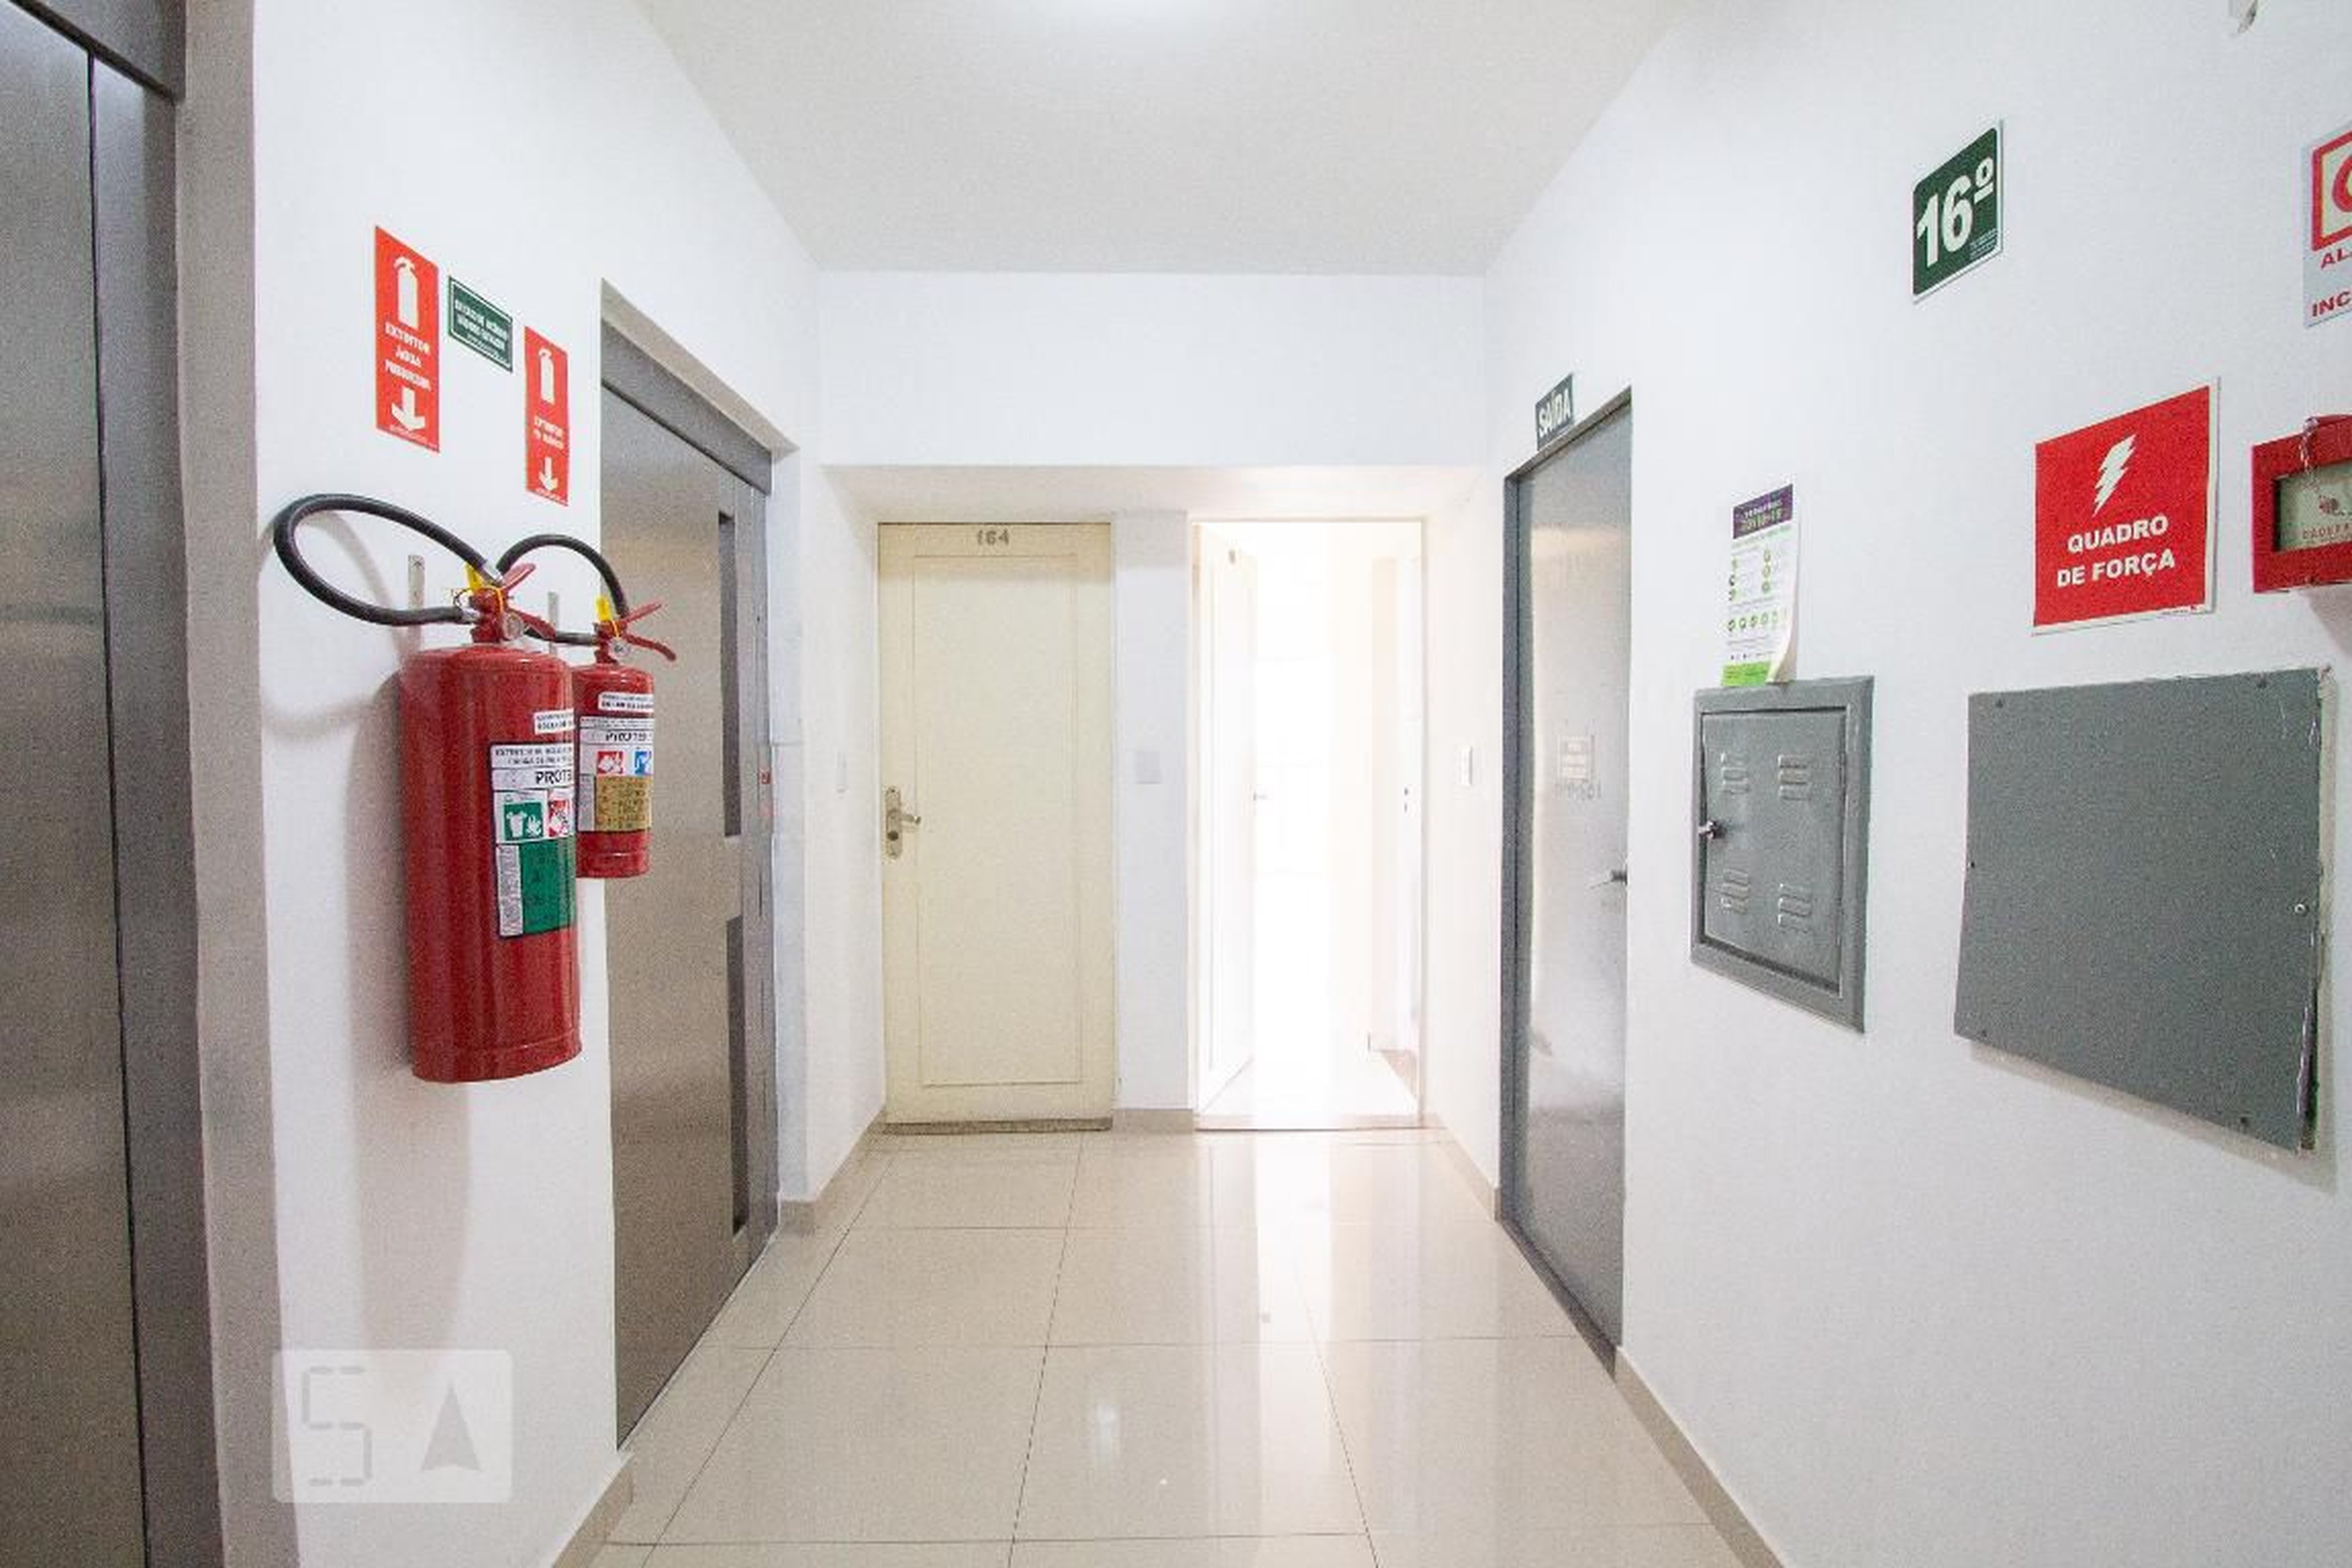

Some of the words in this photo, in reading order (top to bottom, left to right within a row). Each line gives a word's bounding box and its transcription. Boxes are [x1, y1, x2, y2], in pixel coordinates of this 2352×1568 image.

[1917, 156, 1994, 269] 16º
[977, 529, 1009, 546] 164
[2067, 514, 2169, 554] QUADRO
[2057, 565, 2086, 588] DE
[2092, 548, 2176, 581] FORÇA
